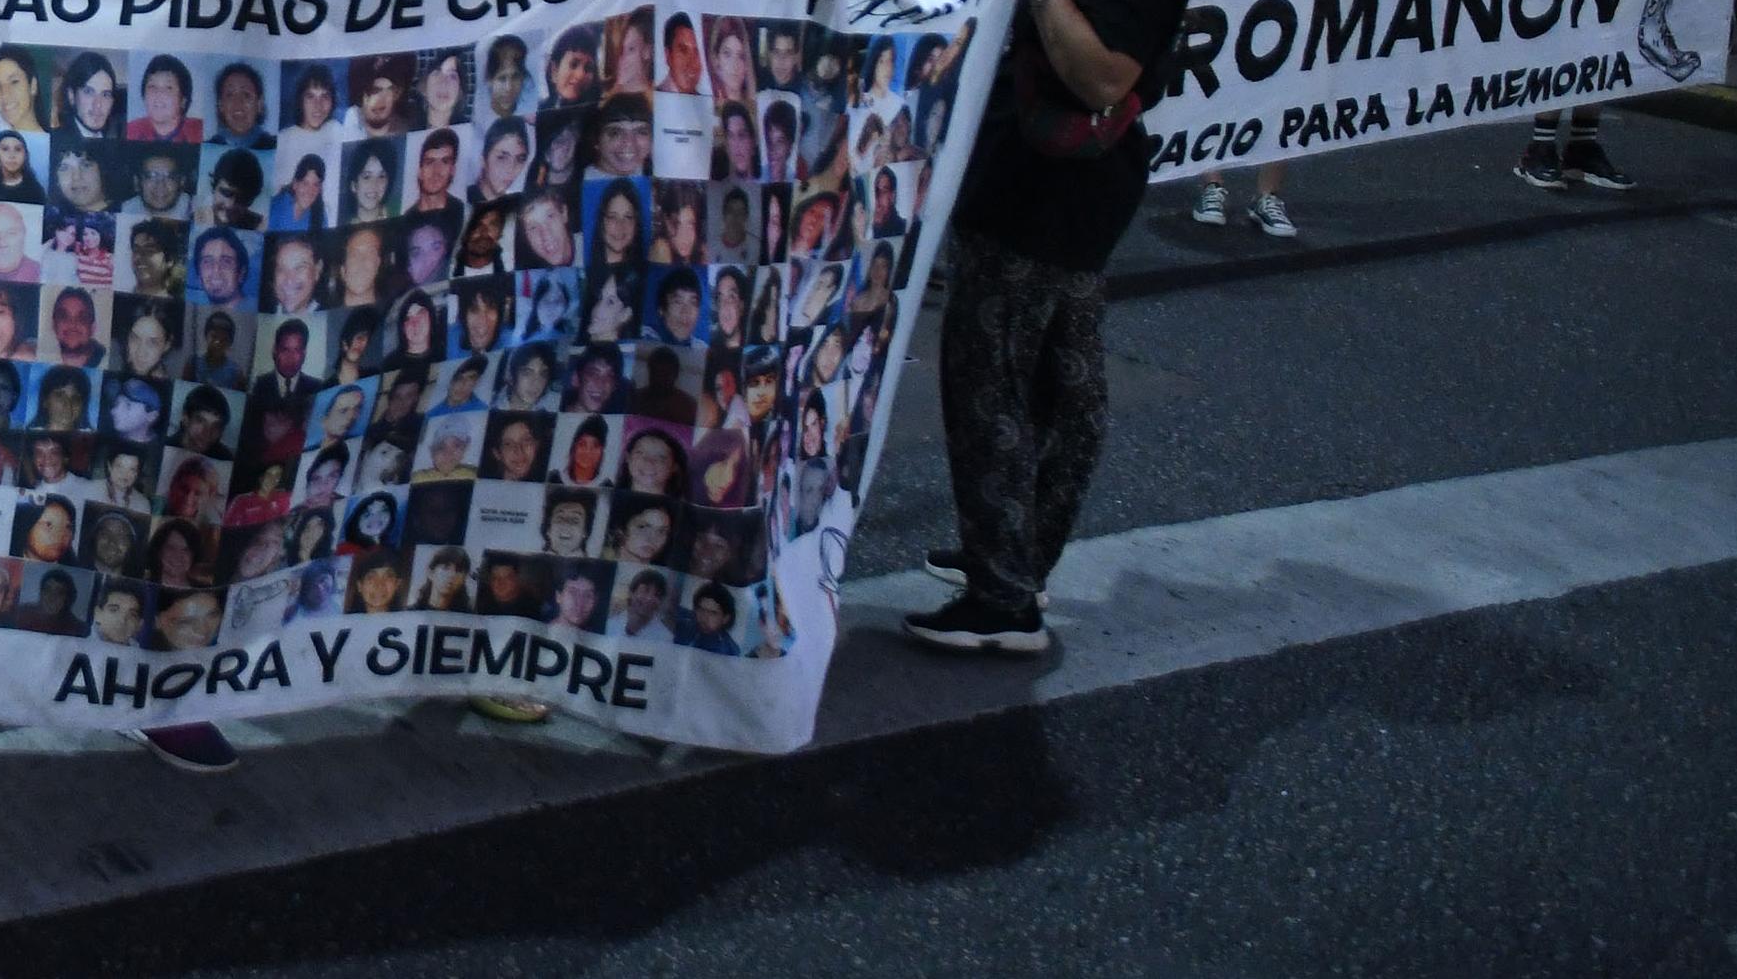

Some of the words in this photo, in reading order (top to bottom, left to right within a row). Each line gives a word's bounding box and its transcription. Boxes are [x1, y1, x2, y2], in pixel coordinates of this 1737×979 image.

[1278, 93, 1391, 150] PARA
[1405, 81, 1456, 128] LA
[1464, 50, 1633, 117] MEMORIA
[54, 641, 291, 710] AHORA
[310, 628, 351, 683] Y
[365, 624, 656, 710] SIEMPRE
